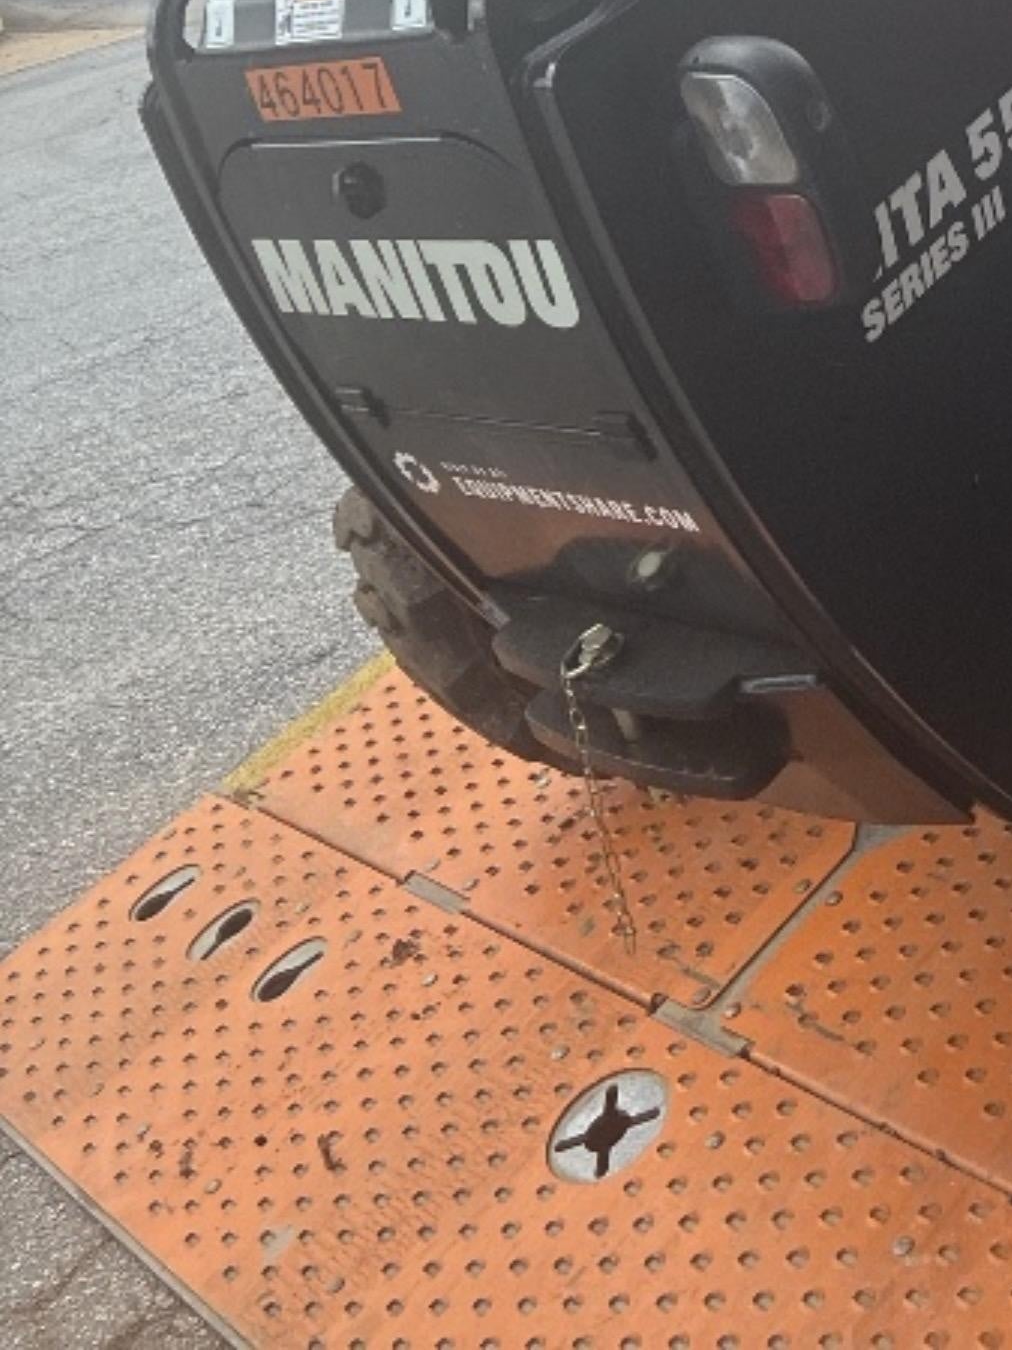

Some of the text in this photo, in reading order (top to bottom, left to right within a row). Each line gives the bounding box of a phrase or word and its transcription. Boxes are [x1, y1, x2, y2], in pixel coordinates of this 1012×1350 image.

[258, 62, 387, 118] 464017
[251, 239, 580, 329] MANITOU
[861, 185, 1006, 343] SERIES III
[452, 476, 700, 533] EQUIPMENTSHARE.COM
